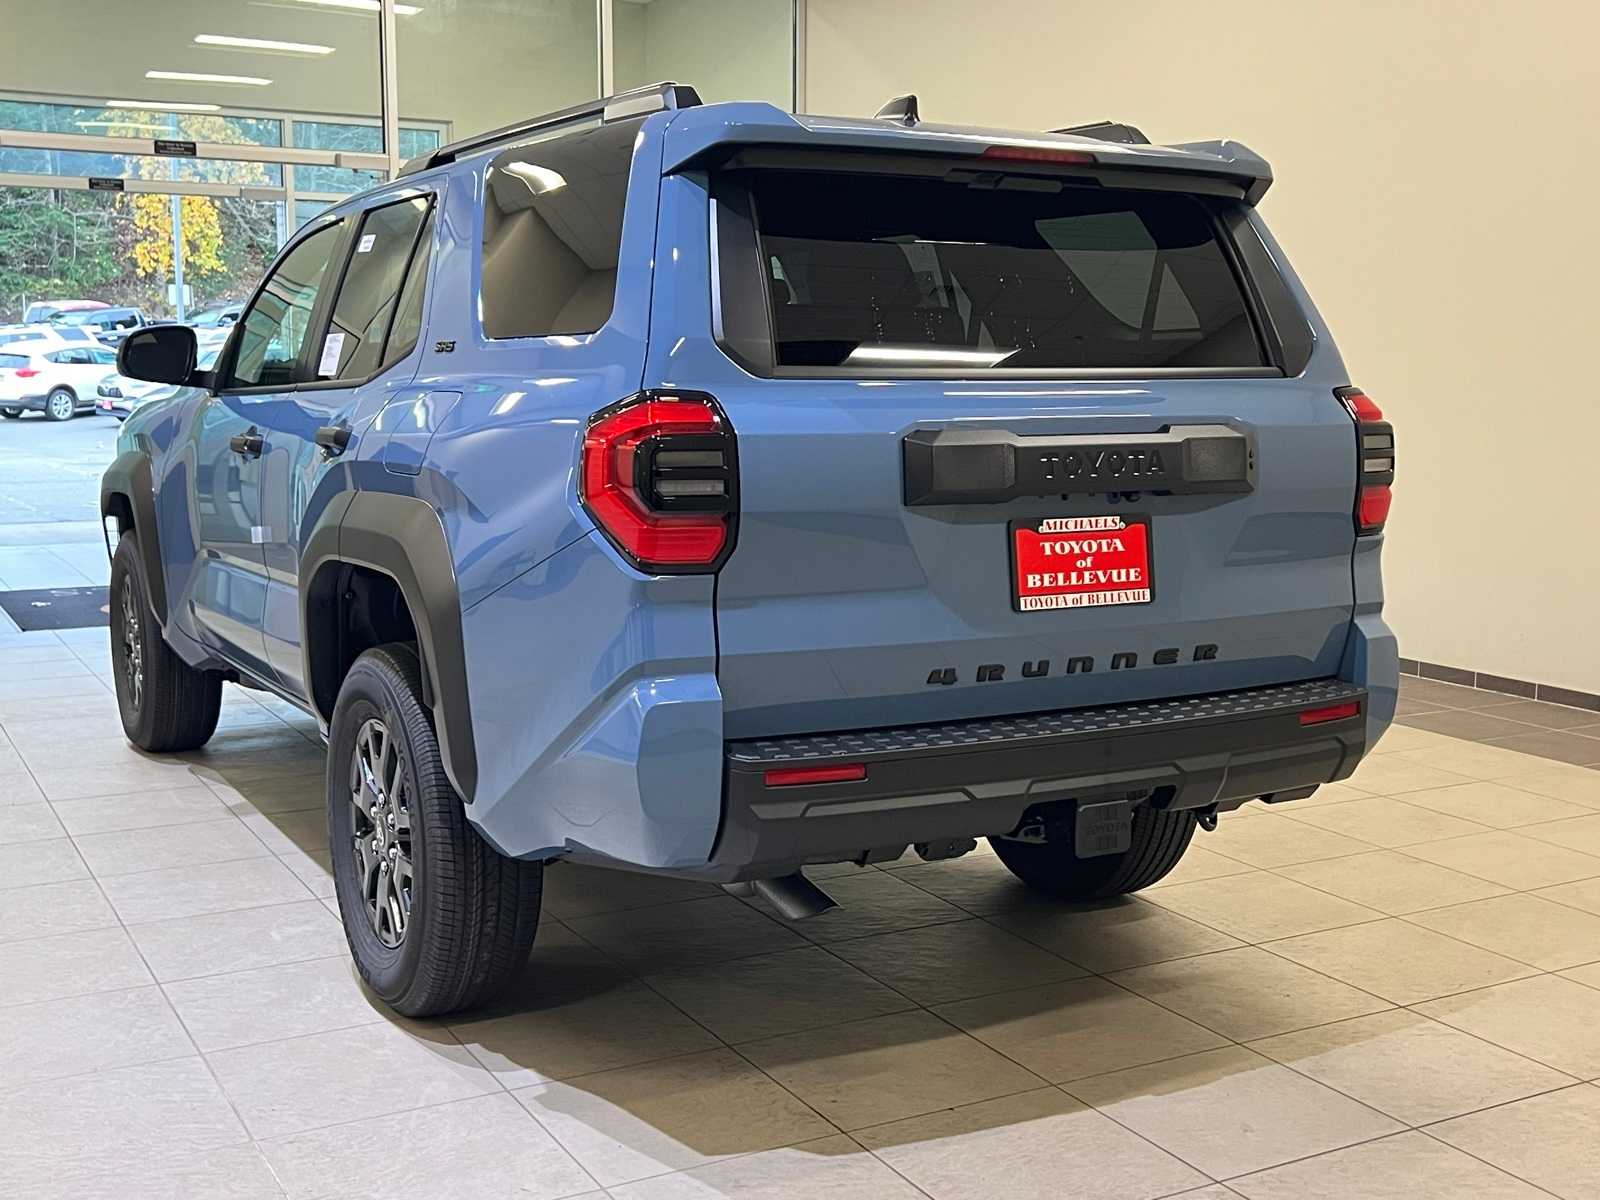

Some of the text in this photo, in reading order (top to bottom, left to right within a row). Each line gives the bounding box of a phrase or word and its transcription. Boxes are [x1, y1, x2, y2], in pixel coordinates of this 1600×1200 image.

[1039, 449, 1165, 480] TOYOTA
[1044, 517, 1119, 531] MICHAELS
[1039, 538, 1126, 556] TOYOTA
[1075, 556, 1094, 569] of
[1026, 567, 1142, 588] BELLEVUE
[1022, 589, 1149, 609] TOYOTA of BELLEVUE
[926, 643, 1219, 686] 4RUNNER
